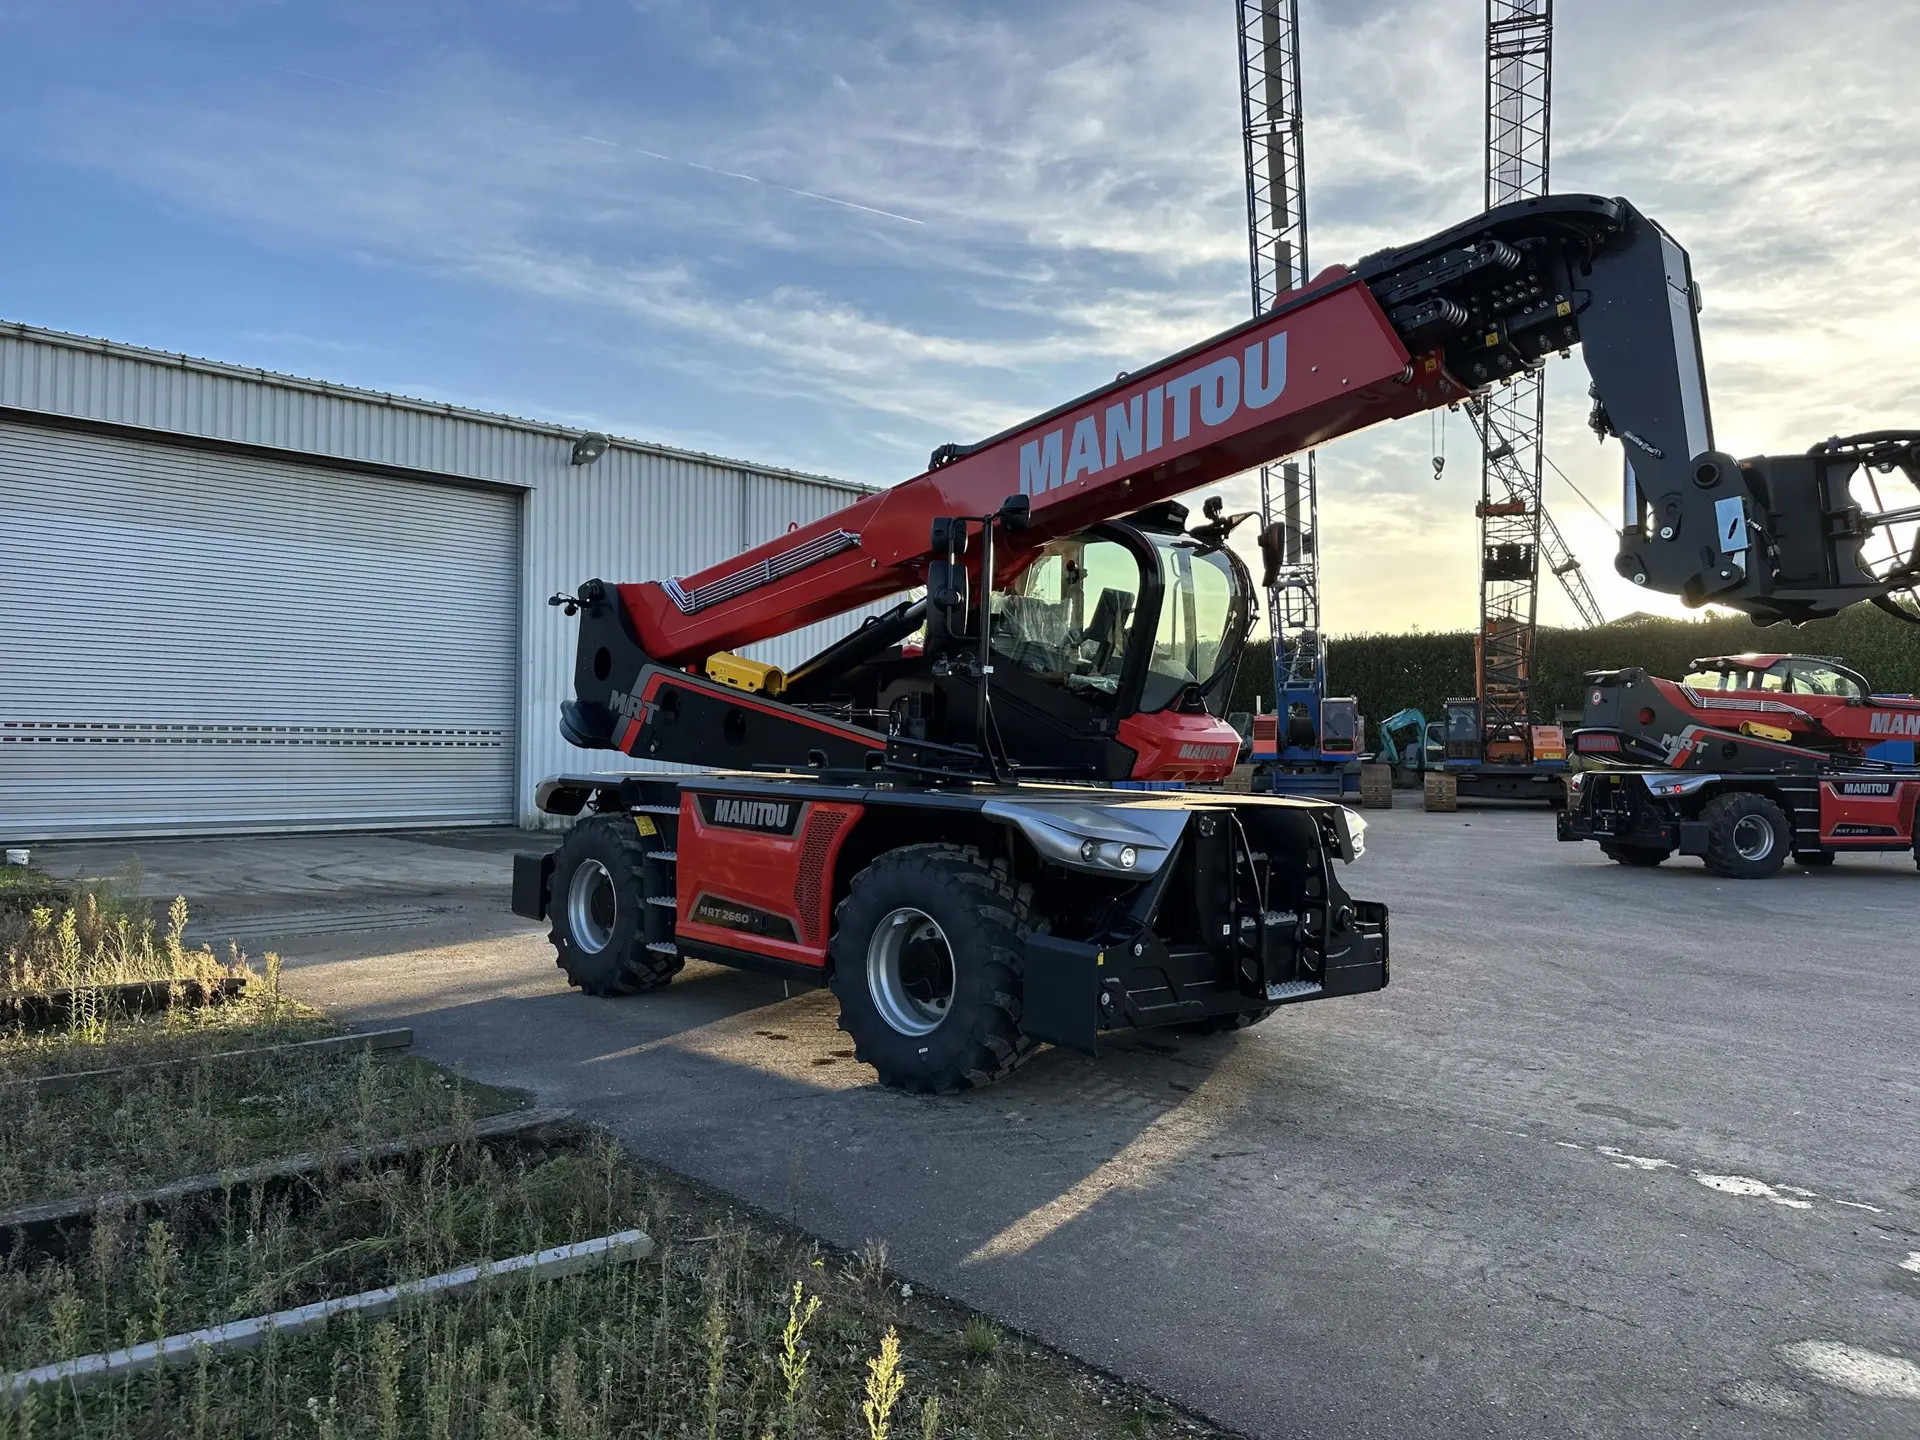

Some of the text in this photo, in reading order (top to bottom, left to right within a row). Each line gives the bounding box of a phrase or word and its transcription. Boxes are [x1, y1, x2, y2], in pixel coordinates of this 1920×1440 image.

[1019, 331, 1287, 496] MANITOU
[608, 689, 660, 725] MRT
[1179, 743, 1232, 760] MANITOU
[1661, 733, 1709, 754] MRT
[1844, 783, 1889, 794] MANITOU
[714, 799, 790, 828] MANITOU
[700, 905, 749, 924] MRT 2660
